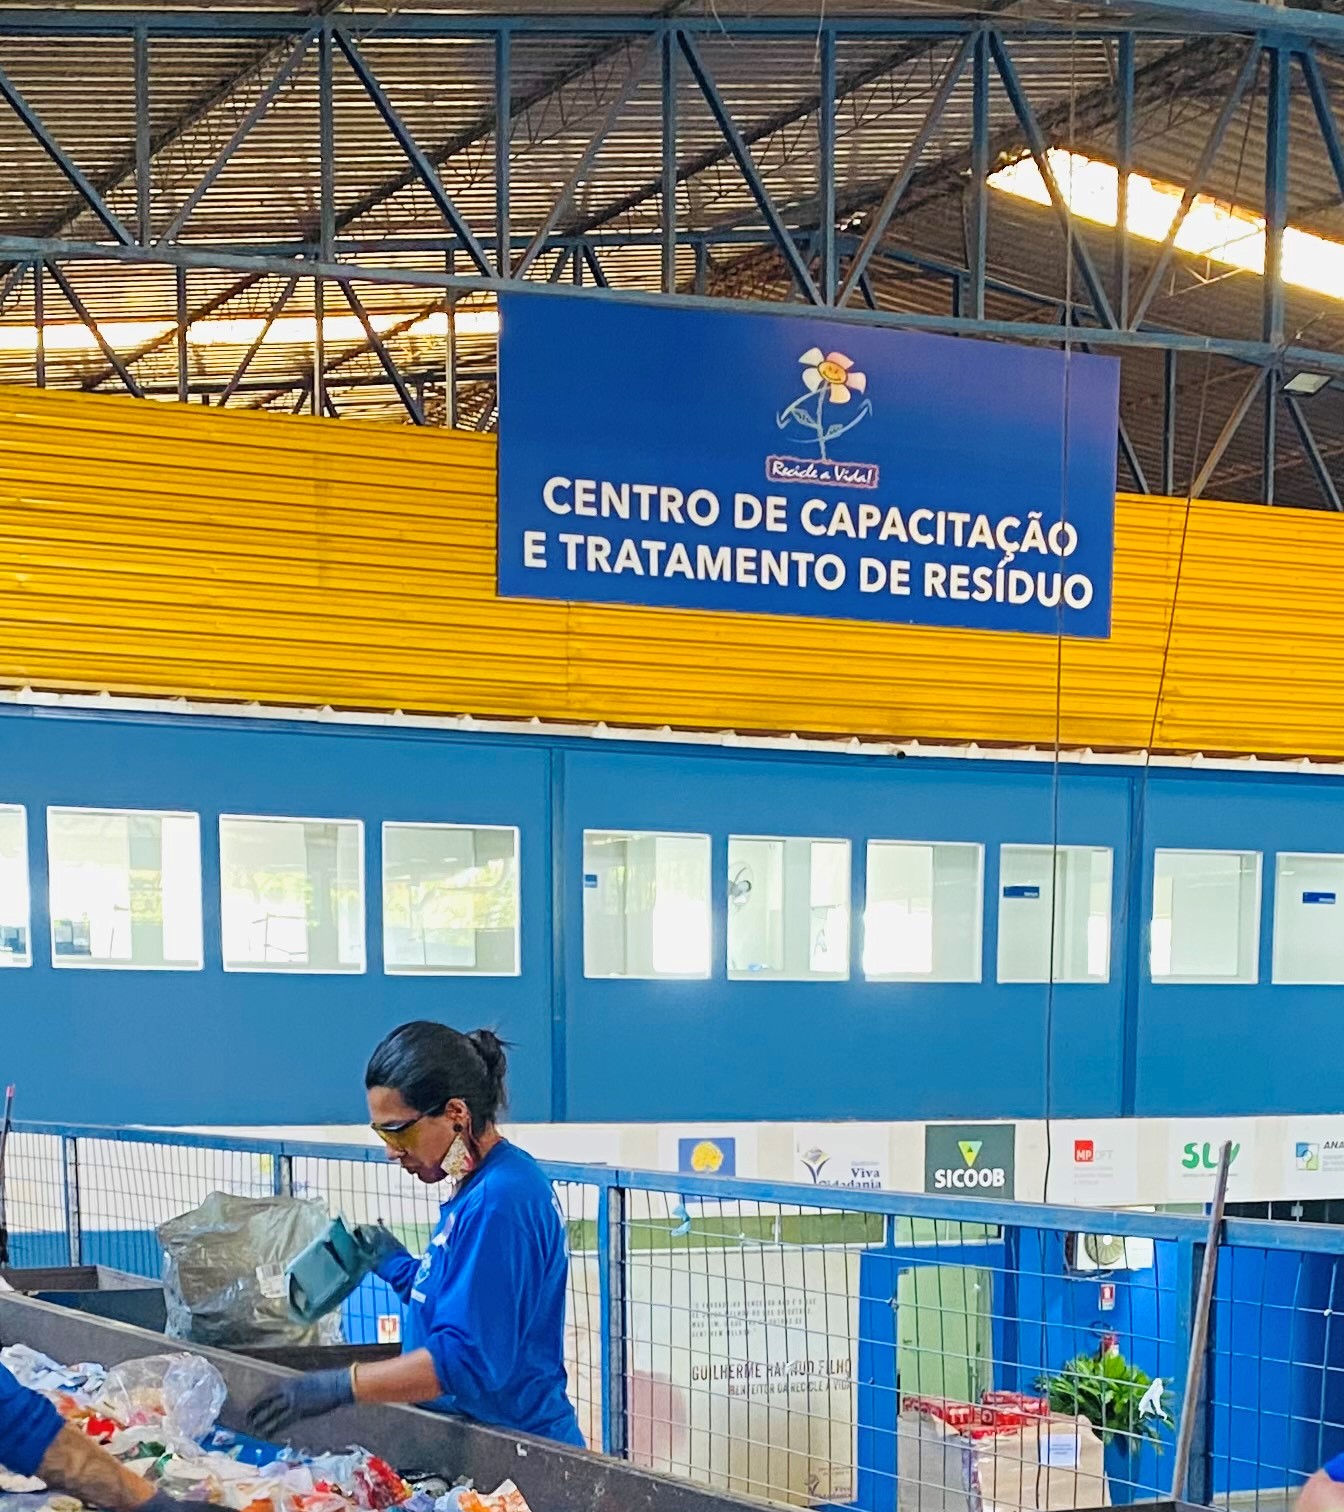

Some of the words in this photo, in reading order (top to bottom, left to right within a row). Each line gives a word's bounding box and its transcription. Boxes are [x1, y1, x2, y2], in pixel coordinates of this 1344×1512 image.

[772, 460, 818, 480] Recicle
[820, 470, 831, 480] a
[834, 465, 873, 484] Vida!
[542, 477, 720, 526] CENTRO
[734, 494, 787, 533] DE
[800, 499, 1079, 562] CAPACITAÇÃO
[523, 531, 547, 568] E
[559, 533, 846, 591] TRATAMENTO
[859, 558, 911, 596] DE
[924, 560, 1094, 610] RESÍDUO
[851, 1167, 881, 1179] Viva
[934, 1167, 1006, 1189] SICOOB
[728, 1382, 774, 1396] BENEITOR
[790, 1380, 823, 1394] RECCLE
